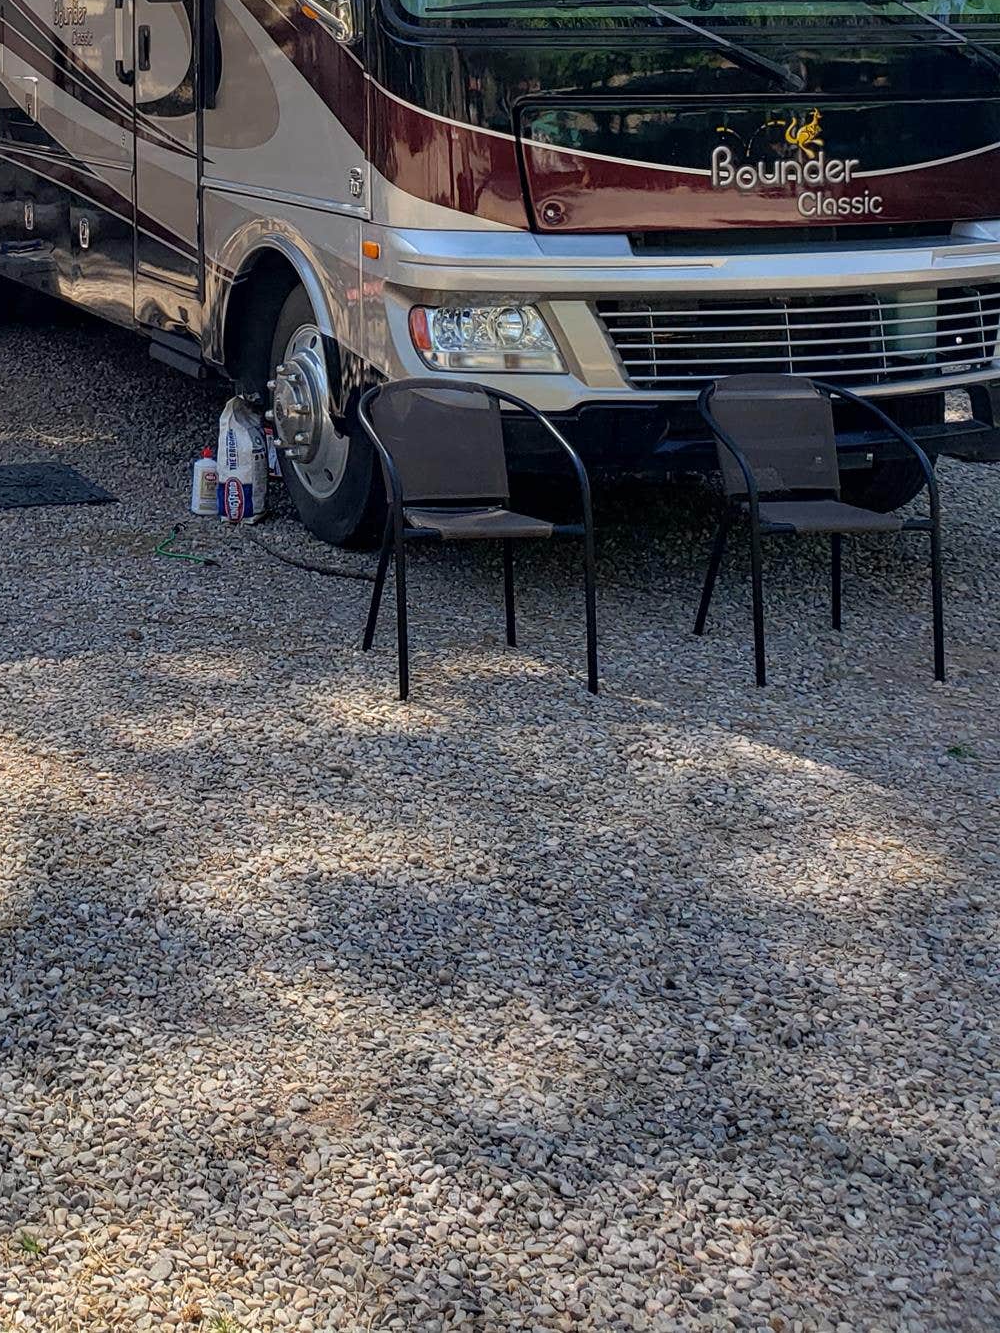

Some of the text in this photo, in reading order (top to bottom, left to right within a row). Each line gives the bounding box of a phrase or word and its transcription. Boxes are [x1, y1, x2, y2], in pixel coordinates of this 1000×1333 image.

[712, 145, 860, 189] Bounder
[798, 190, 884, 216] Classic
[229, 458, 237, 471] THE
